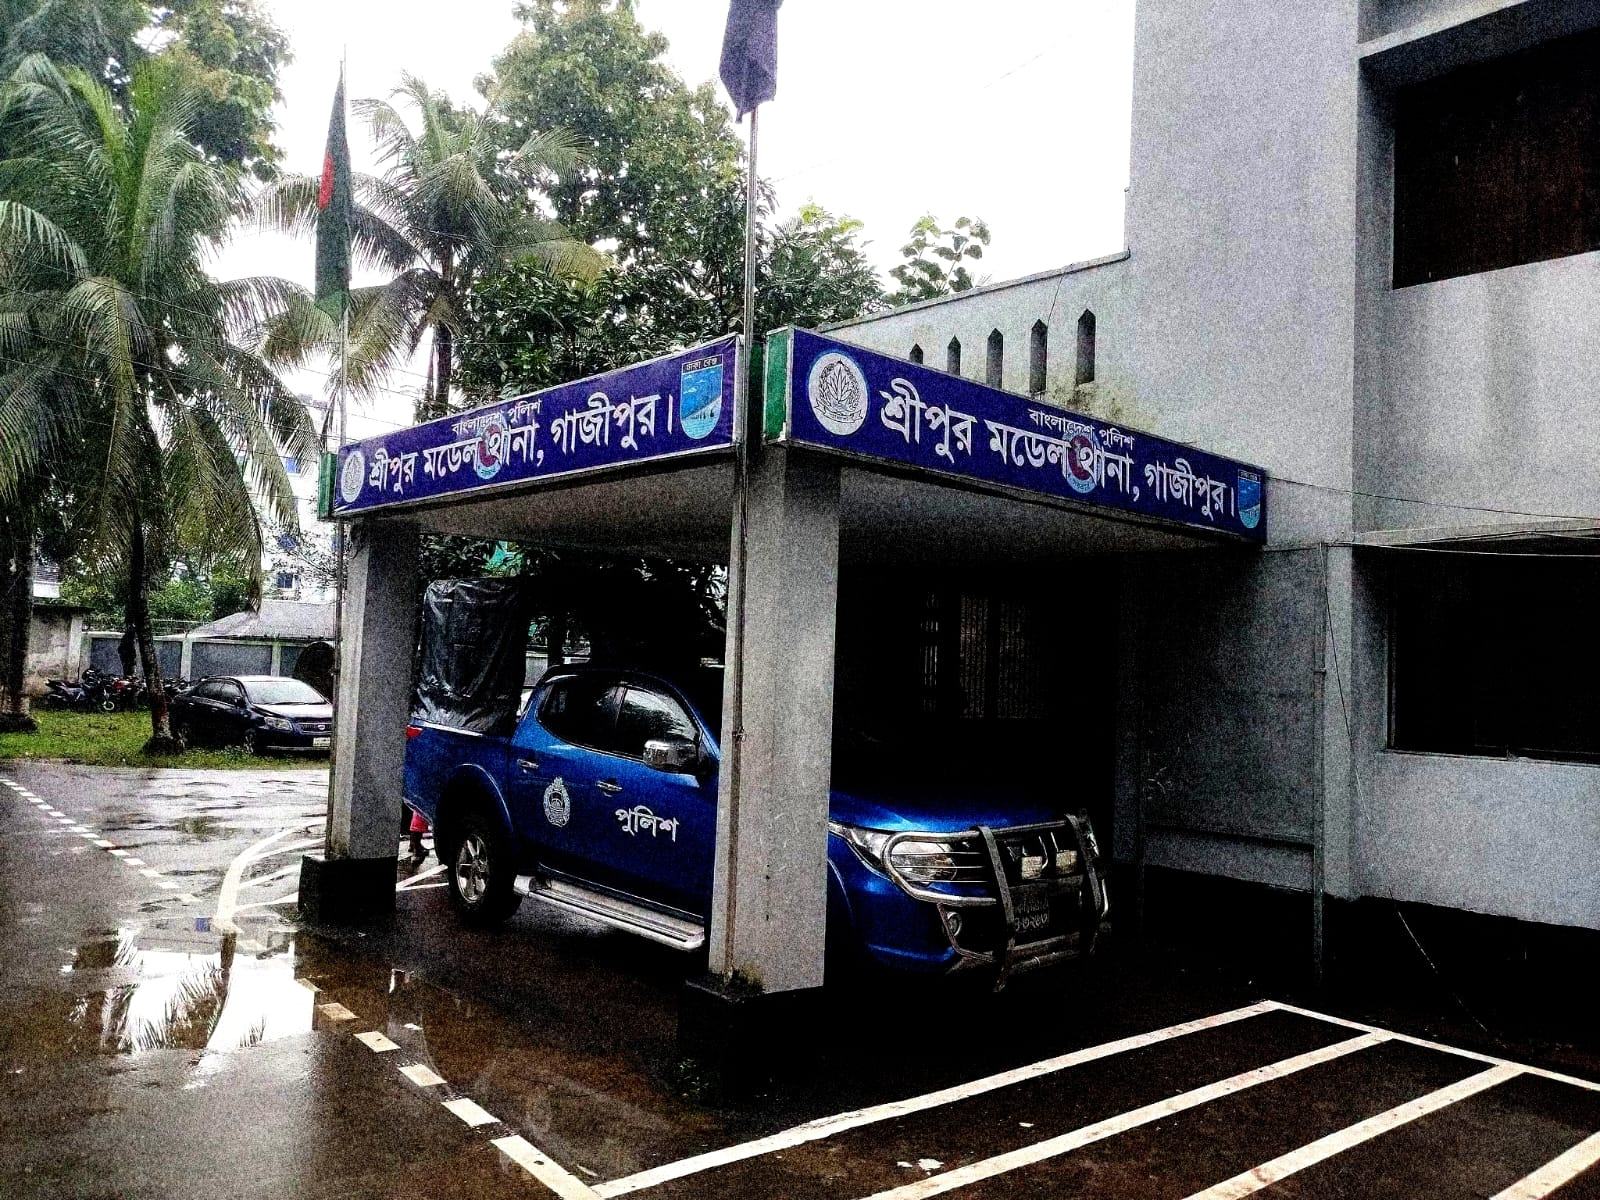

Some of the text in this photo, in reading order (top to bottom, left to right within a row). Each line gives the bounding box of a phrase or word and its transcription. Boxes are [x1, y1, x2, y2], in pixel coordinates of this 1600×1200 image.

[451, 398, 543, 437] বাংলাদেশ পুলিশ
[1027, 408, 1136, 451] বাংলাদেশ পুলিশ
[369, 447, 420, 495] শ্রীপুর
[422, 436, 482, 481] মডেল
[488, 418, 544, 468] থানা,
[879, 377, 979, 464] শ্রীপুর
[984, 419, 1071, 480] মডেল
[1079, 442, 1140, 502] থানা,
[614, 804, 681, 843] পুলিশ
